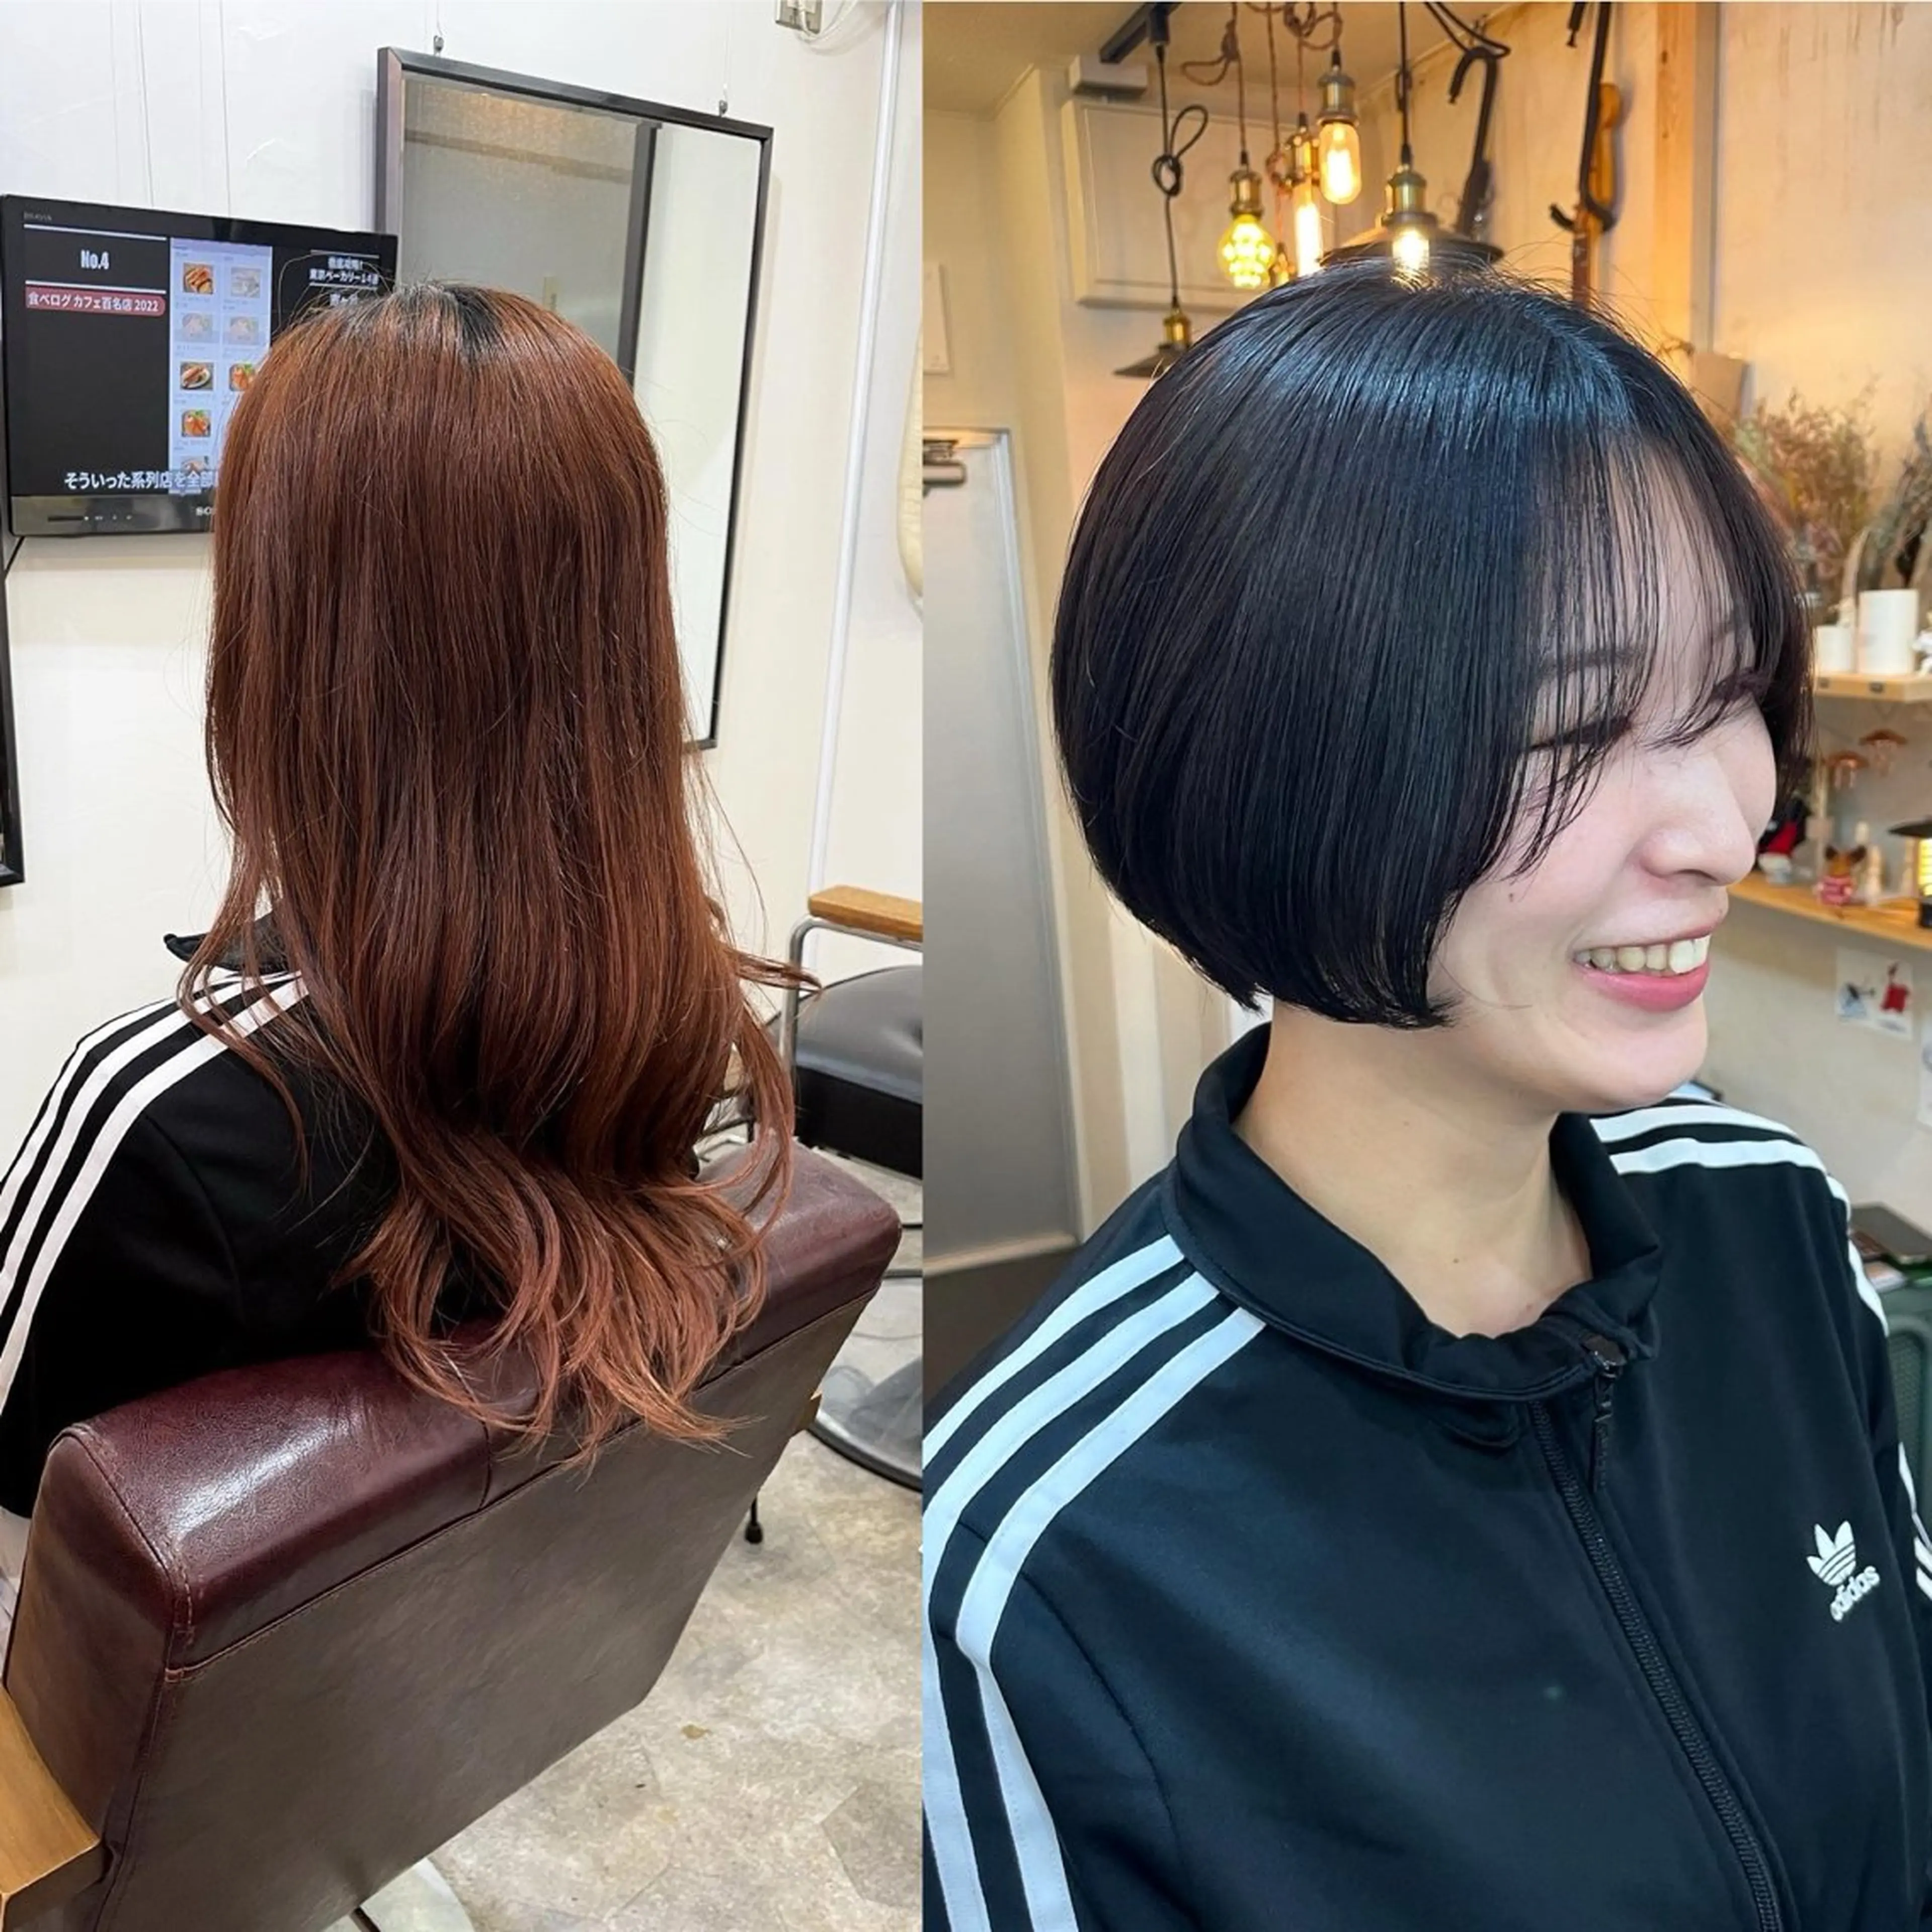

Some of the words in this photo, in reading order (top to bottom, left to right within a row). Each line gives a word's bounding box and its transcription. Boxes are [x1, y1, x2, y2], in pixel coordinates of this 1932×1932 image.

[80, 249, 110, 270] No.4
[28, 292, 70, 307] 食べログ
[134, 300, 159, 312] 2022
[64, 470, 218, 490] そういった系列店を全部
[1830, 1566, 1880, 1620] adidas
